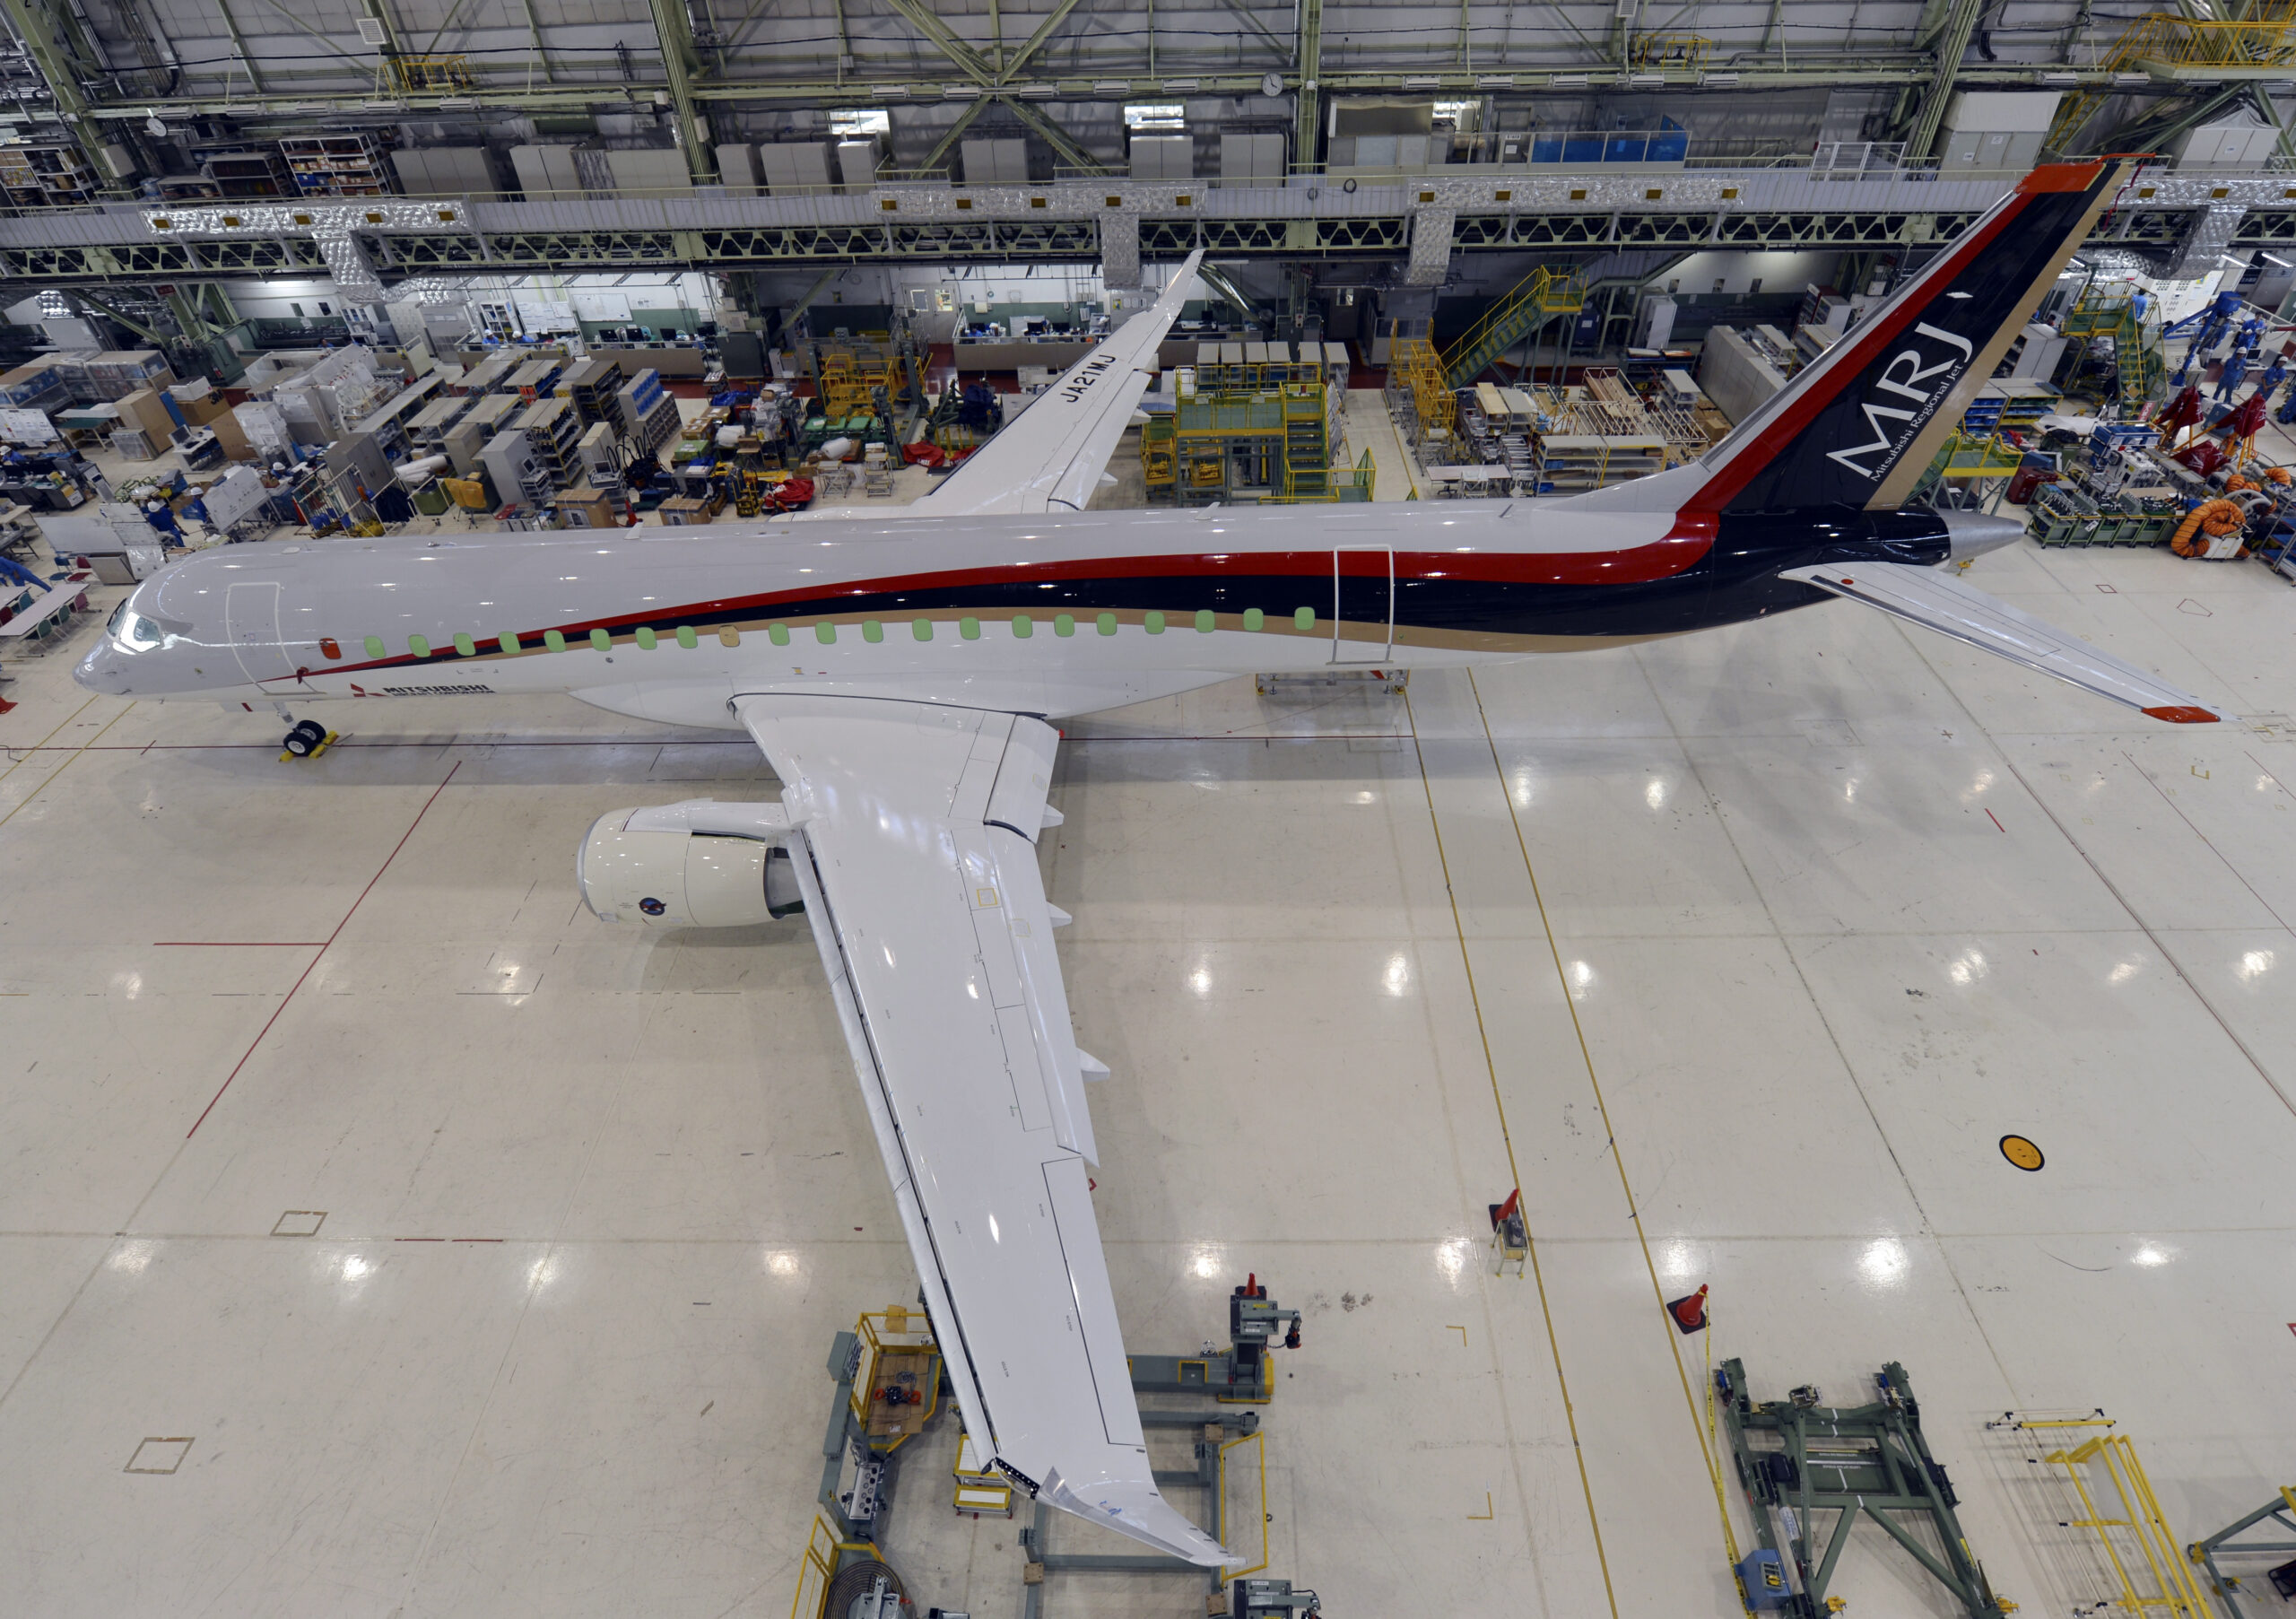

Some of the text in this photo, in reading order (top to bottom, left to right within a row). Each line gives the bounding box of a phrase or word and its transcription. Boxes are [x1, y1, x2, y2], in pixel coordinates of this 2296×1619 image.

[1060, 354, 1117, 403] JA21MJ
[1825, 321, 1973, 478] MRJ
[1870, 364, 1964, 482] Mitsubishi Regional Jet
[382, 684, 490, 692] MITSUBISHI
